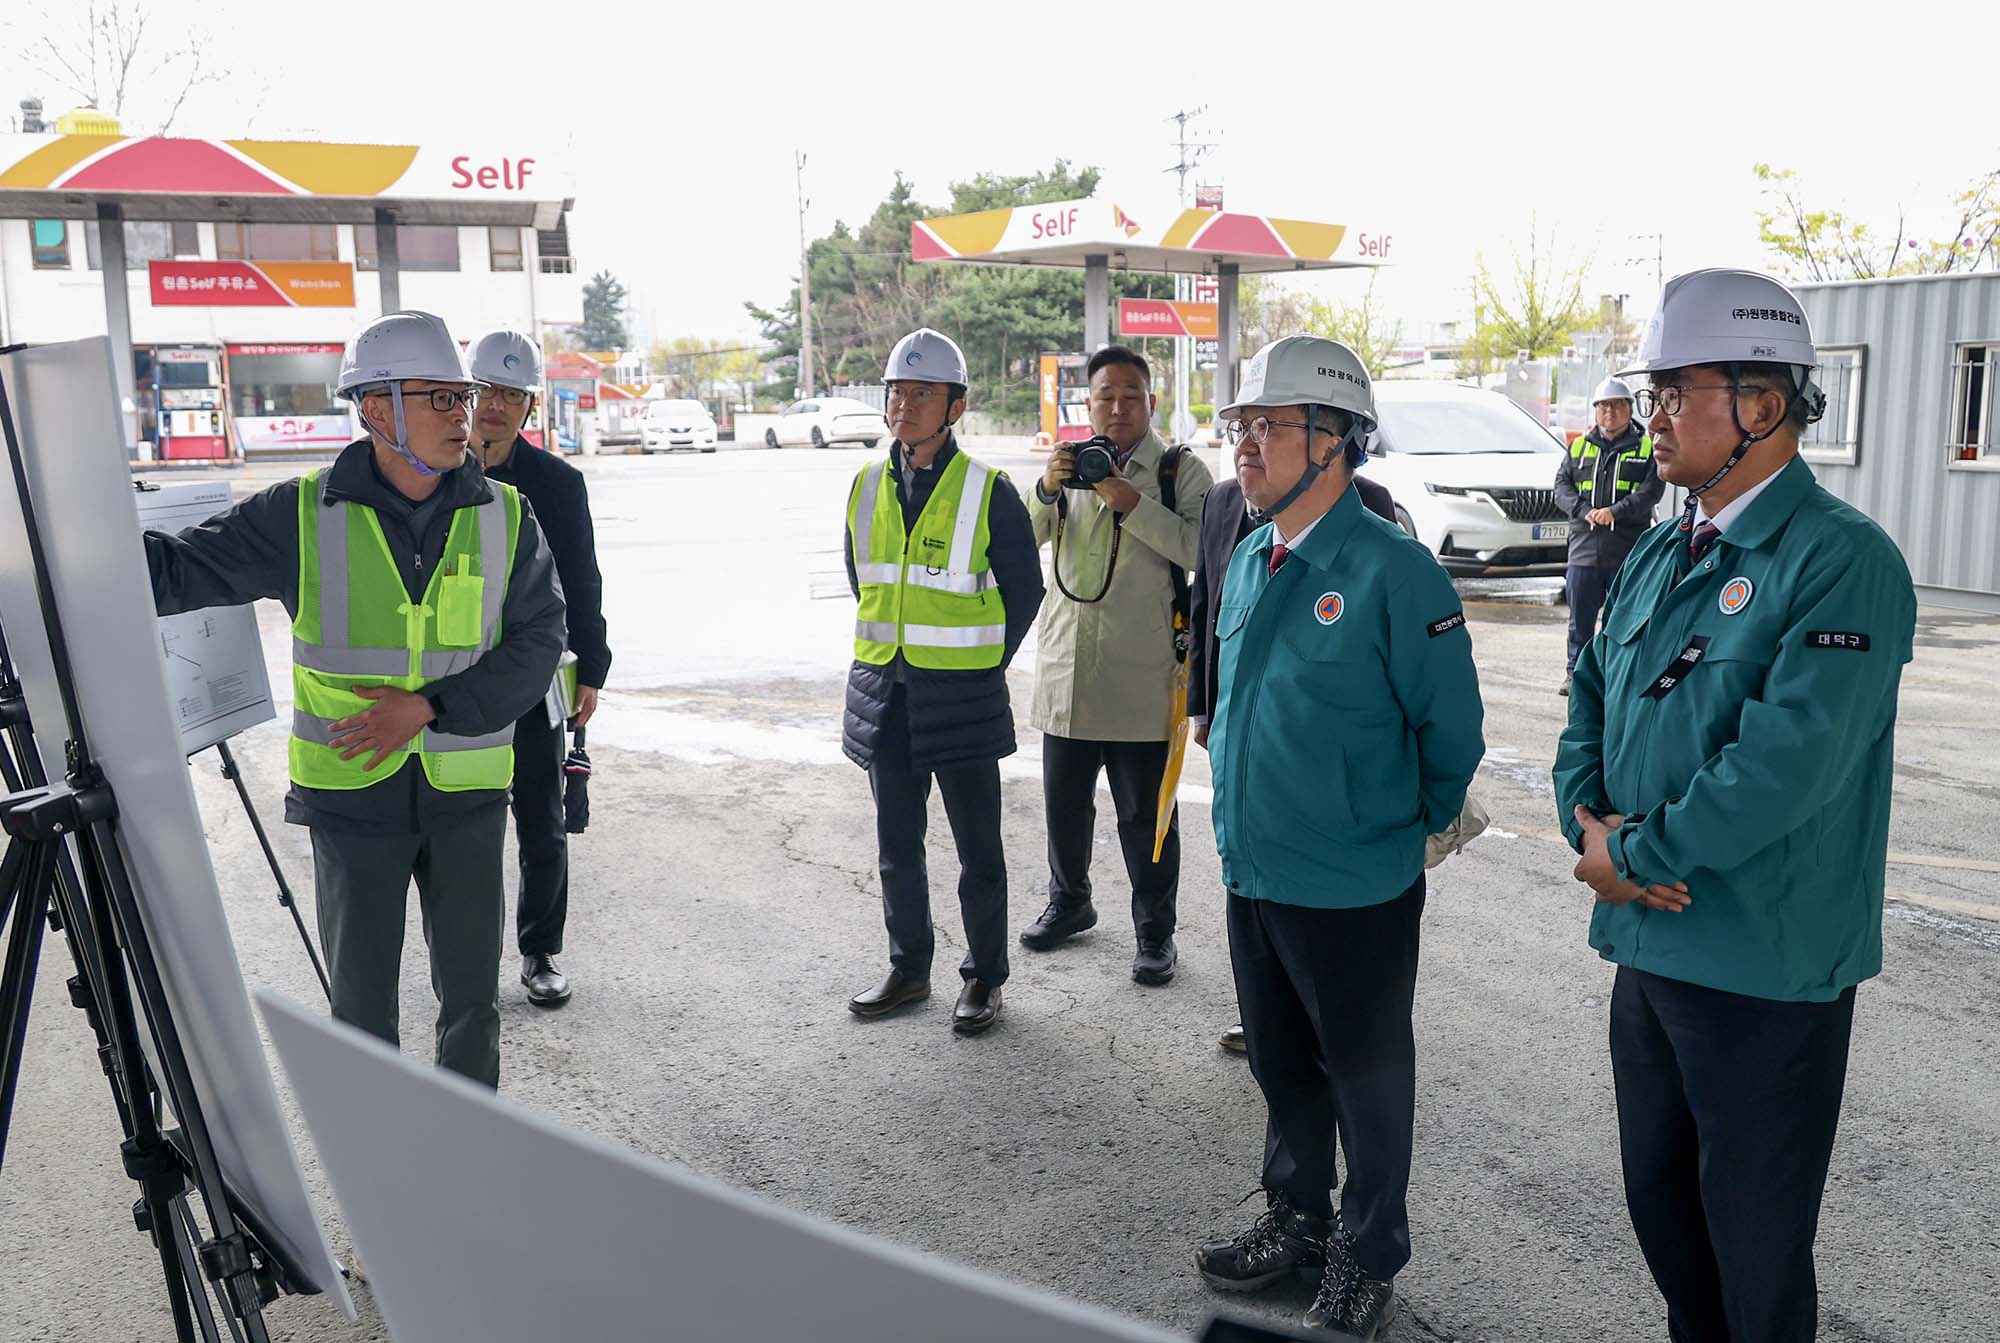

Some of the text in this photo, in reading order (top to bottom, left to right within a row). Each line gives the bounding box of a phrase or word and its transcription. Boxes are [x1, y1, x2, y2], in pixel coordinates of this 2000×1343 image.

[452, 156, 536, 190] Self
[1032, 208, 1079, 239] Self
[1358, 233, 1393, 258] Self
[1732, 308, 1801, 325] (주)원평종합건설
[1317, 367, 1367, 389] 대전광역시장
[1818, 633, 1860, 647] 대덕구
